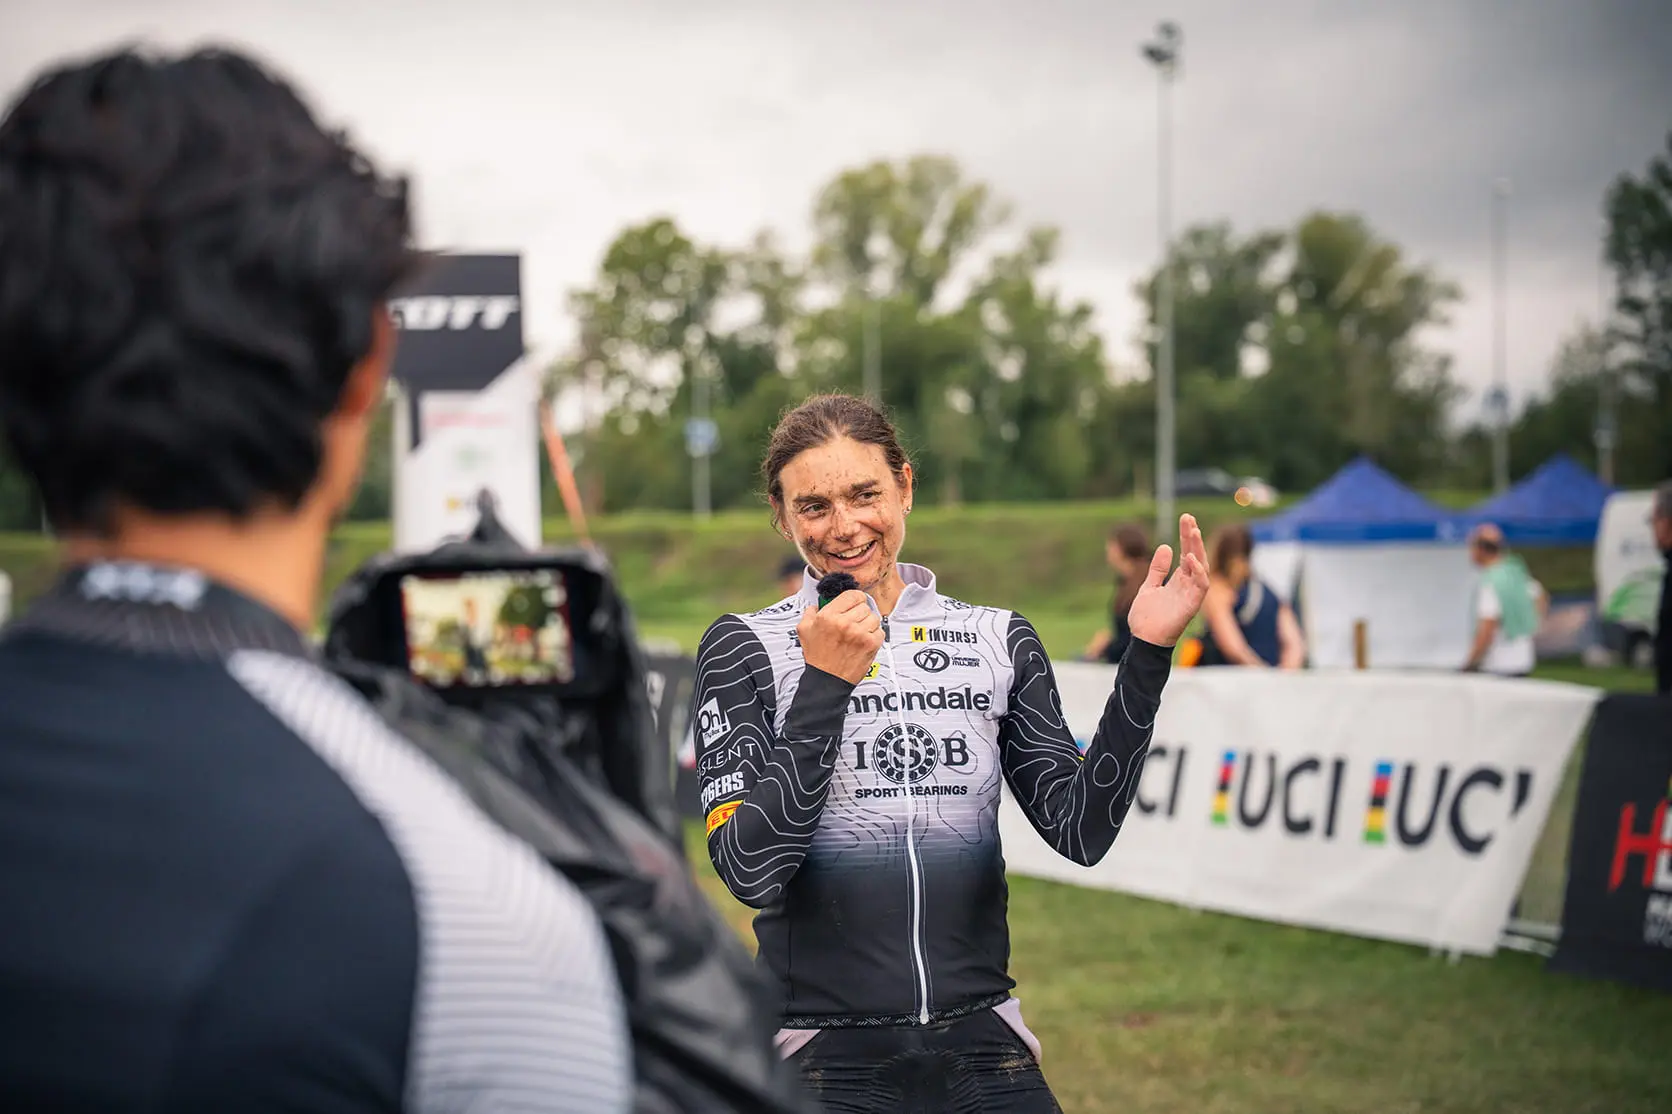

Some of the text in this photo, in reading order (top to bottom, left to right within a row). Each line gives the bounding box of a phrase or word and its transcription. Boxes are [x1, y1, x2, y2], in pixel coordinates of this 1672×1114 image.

[845, 686, 990, 714] nnondale
[855, 785, 968, 799] SPORT BEARINGS
[1237, 751, 1346, 838] UCI
